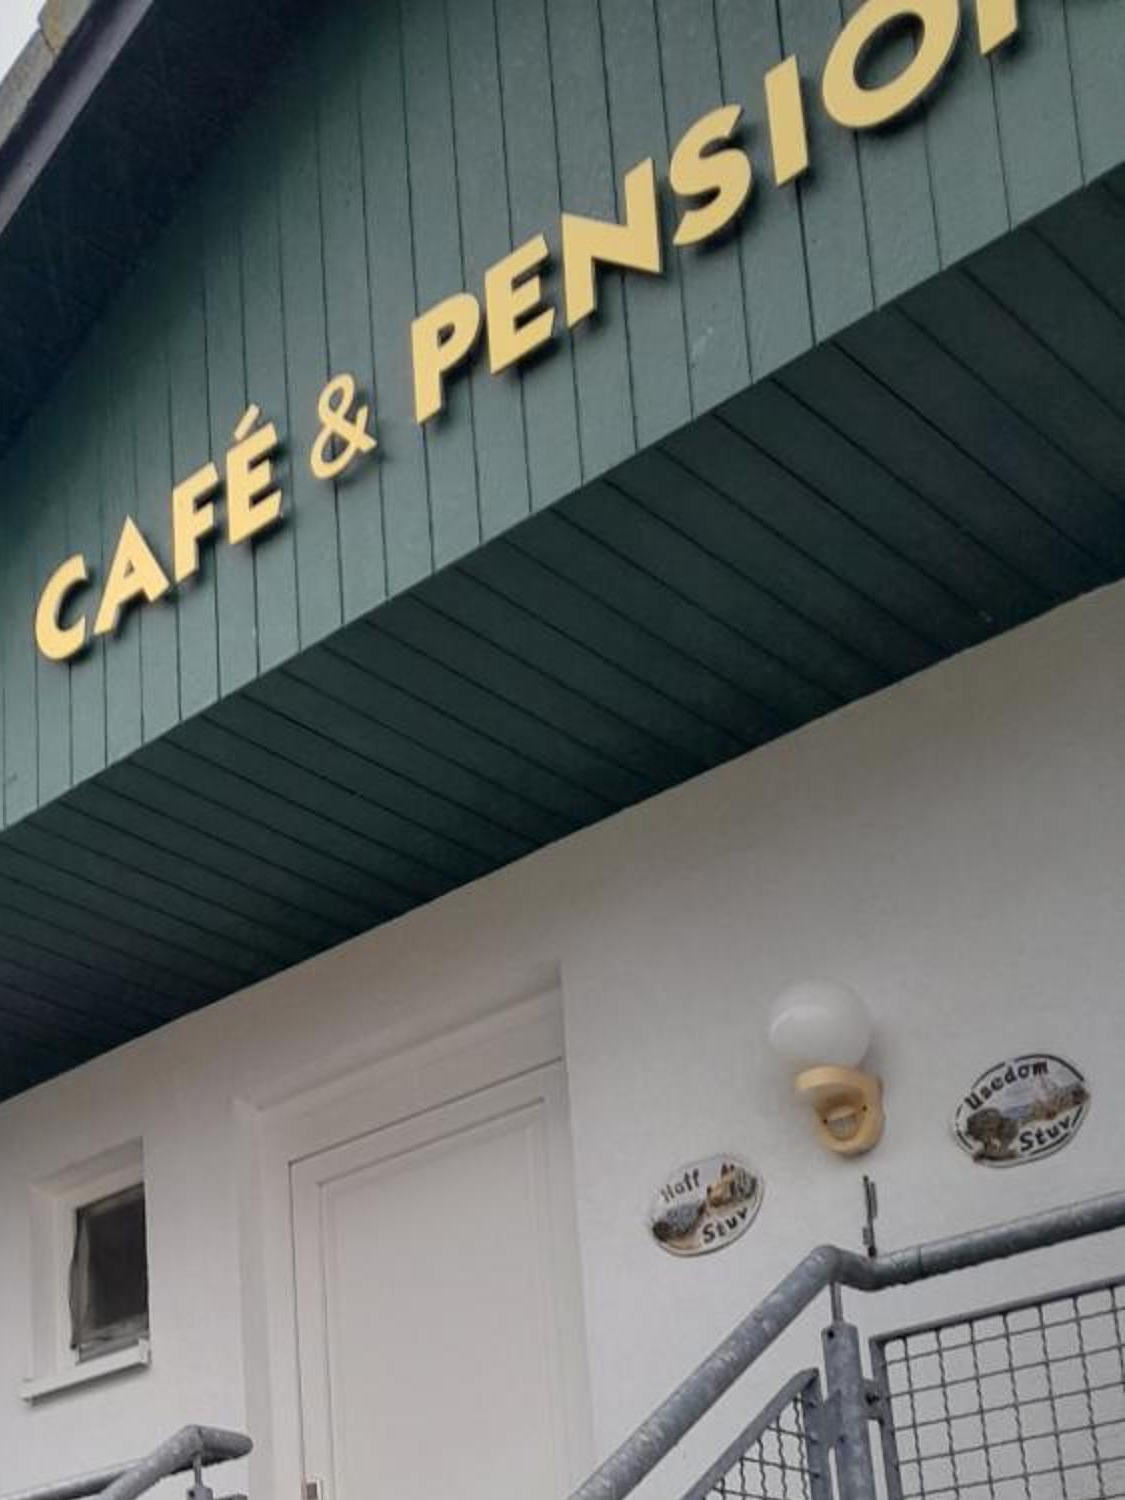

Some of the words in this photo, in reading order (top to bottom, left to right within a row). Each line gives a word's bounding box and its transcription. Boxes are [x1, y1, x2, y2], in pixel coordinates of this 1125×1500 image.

[34, 405, 283, 661] CAFÉ
[309, 374, 378, 480] &
[411, 0, 1018, 424] PENSIO
[964, 1061, 1049, 1110] Usedom
[1019, 1115, 1070, 1152] Stuv
[702, 1207, 748, 1244] Stuv
